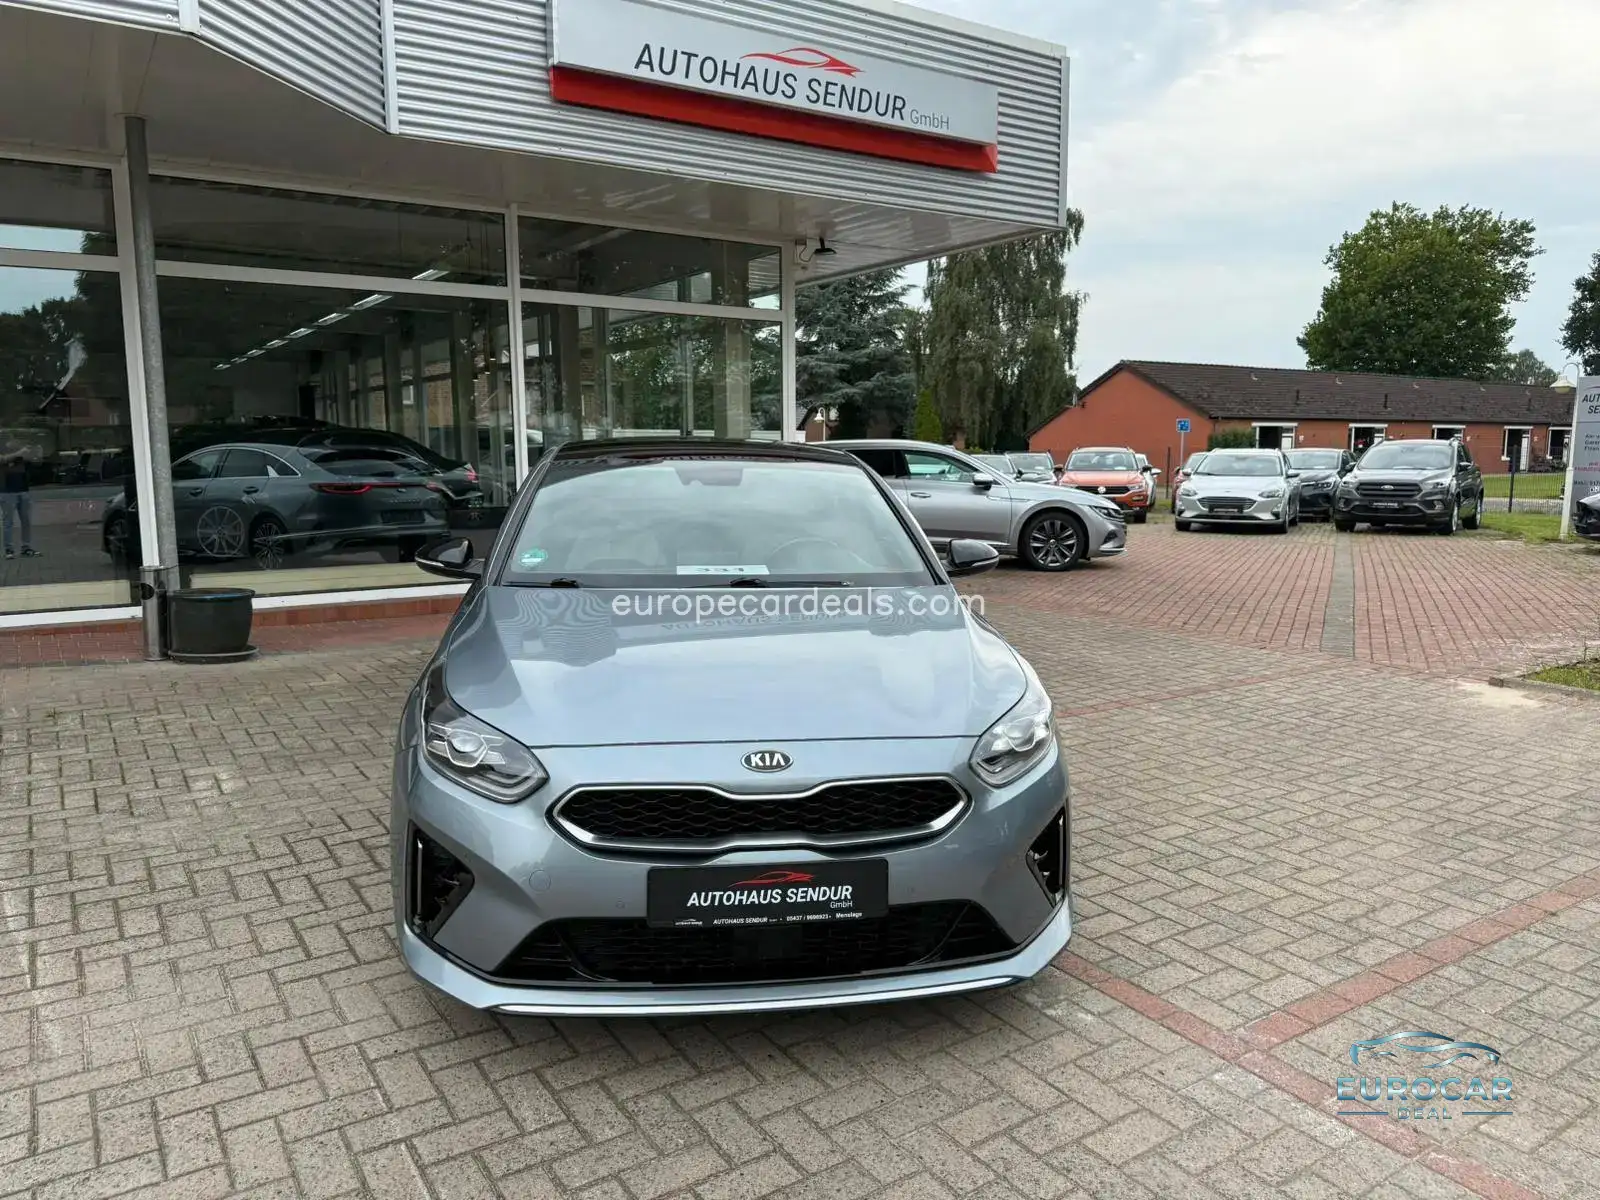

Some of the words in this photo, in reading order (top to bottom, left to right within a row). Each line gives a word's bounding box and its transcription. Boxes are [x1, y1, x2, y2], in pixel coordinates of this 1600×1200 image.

[634, 43, 798, 99] AUTOHAUS
[805, 78, 907, 121] SENDUR
[910, 108, 950, 131] GmbH
[1588, 405, 1600, 414] SE
[750, 752, 786, 767] KIA
[686, 888, 782, 907] AUTOHAUS
[785, 885, 853, 903] SENDUR
[830, 900, 853, 909] GmbH
[713, 917, 744, 925] AUTOHAUS
[745, 916, 768, 924] SENDUR
